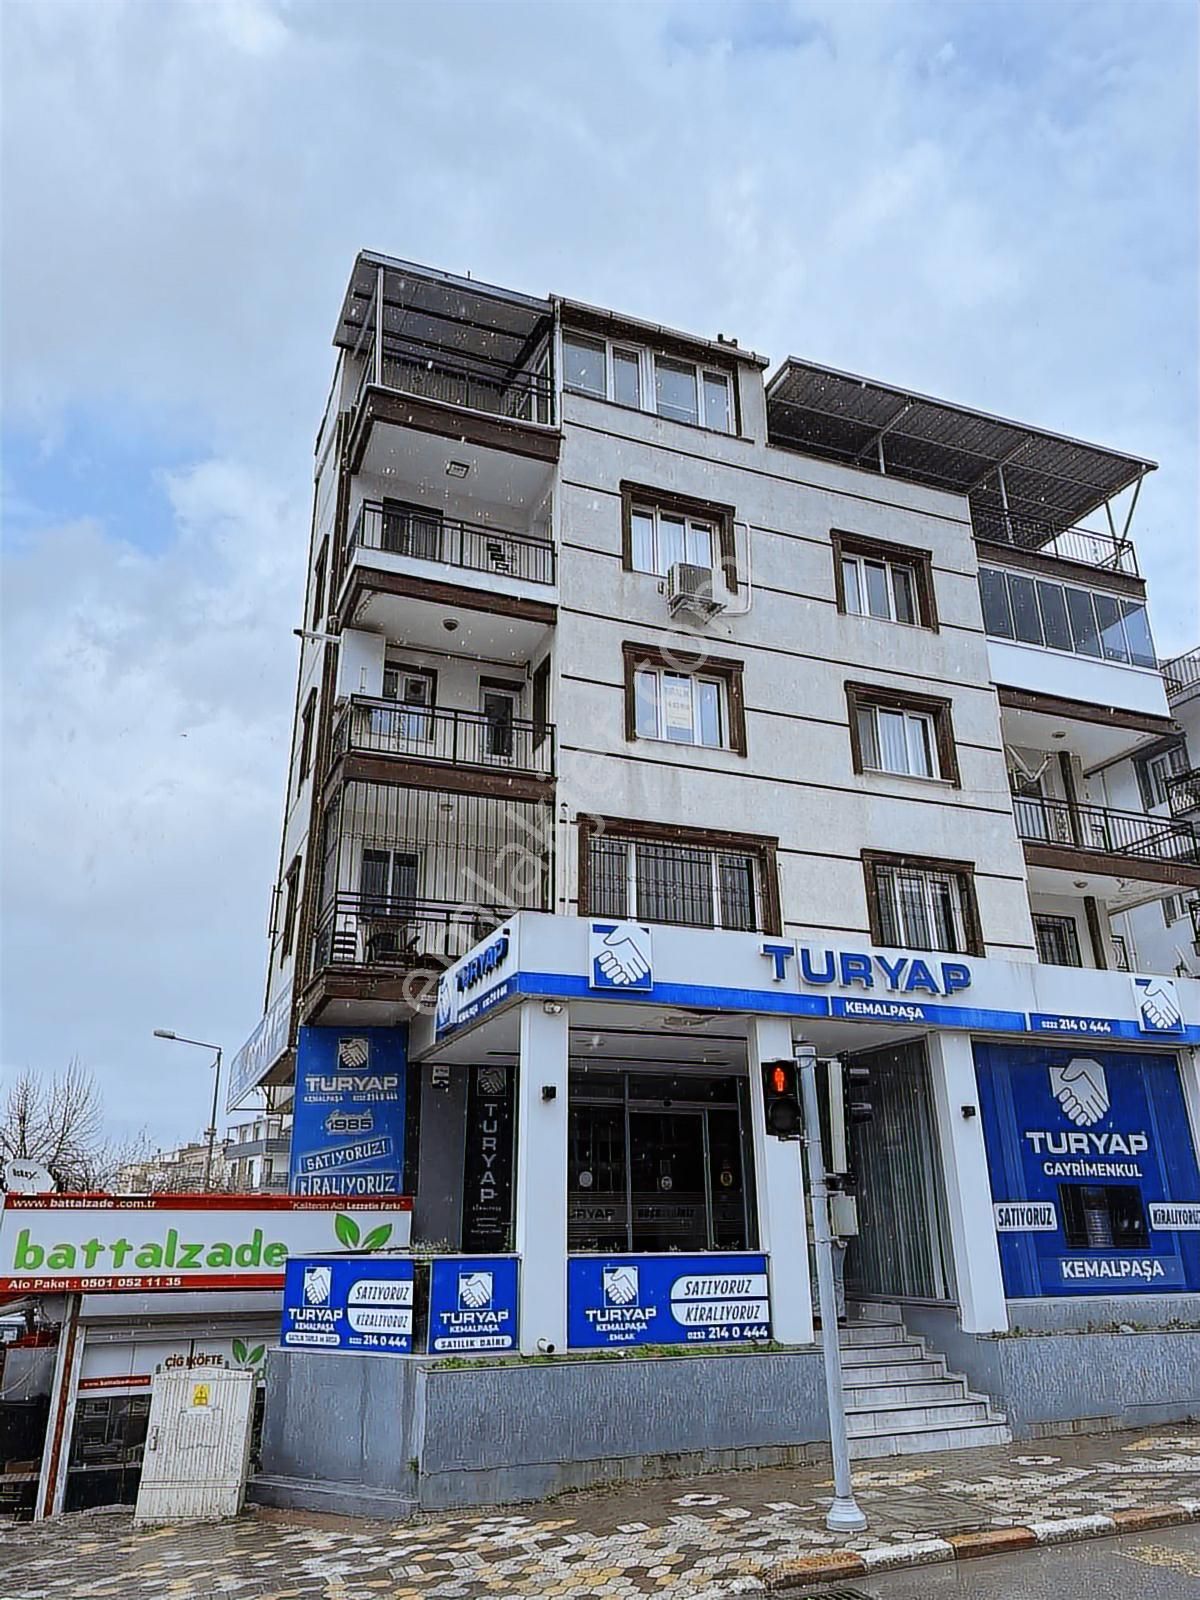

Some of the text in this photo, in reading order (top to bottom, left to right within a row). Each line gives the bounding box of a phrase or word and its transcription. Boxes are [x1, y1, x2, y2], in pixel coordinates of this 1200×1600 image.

[760, 943, 971, 996] TURYAP
[845, 1000, 925, 1021] KEMALPAŞA
[1059, 1018, 1078, 1030] 214
[1080, 1020, 1087, 1031] 0
[1089, 1020, 1111, 1032] 444
[305, 1076, 398, 1091] TURYAP
[325, 1116, 374, 1132] 1985
[1025, 1131, 1149, 1155] TURYAP
[306, 1140, 387, 1170] SATIYORUZ!
[480, 1103, 498, 1203] TURYAP
[1043, 1160, 1143, 1177] GAYRİMENKUL
[300, 1174, 395, 1196] KİRALIYORUZ
[50, 1199, 114, 1208] battalzade
[999, 1207, 1053, 1226] SATIYORUZ
[14, 1228, 289, 1270] battalzade
[1061, 1259, 1165, 1282] KEMALPAŞA
[8, 1280, 30, 1289] Alo
[34, 1279, 70, 1289] Paket
[81, 1278, 112, 1288] 0501
[118, 1278, 141, 1287] 052
[147, 1278, 160, 1287] 11
[166, 1277, 181, 1286] 35
[684, 1279, 753, 1296] SATIYORUZ
[355, 1286, 410, 1300] SATIYORUZ
[288, 1308, 343, 1321] TURYAP
[440, 1310, 509, 1324] TURYAP
[585, 1308, 657, 1323] TURYAP
[685, 1304, 761, 1322] KİRALIYORUZ
[596, 1322, 648, 1332] KEMALPAŞA
[708, 1326, 729, 1339] 214
[732, 1326, 740, 1338] 0
[743, 1325, 768, 1338] 444
[363, 1334, 379, 1345] 214
[380, 1335, 387, 1346] 0
[388, 1336, 407, 1347] 444
[440, 1339, 475, 1348] SATILIK
